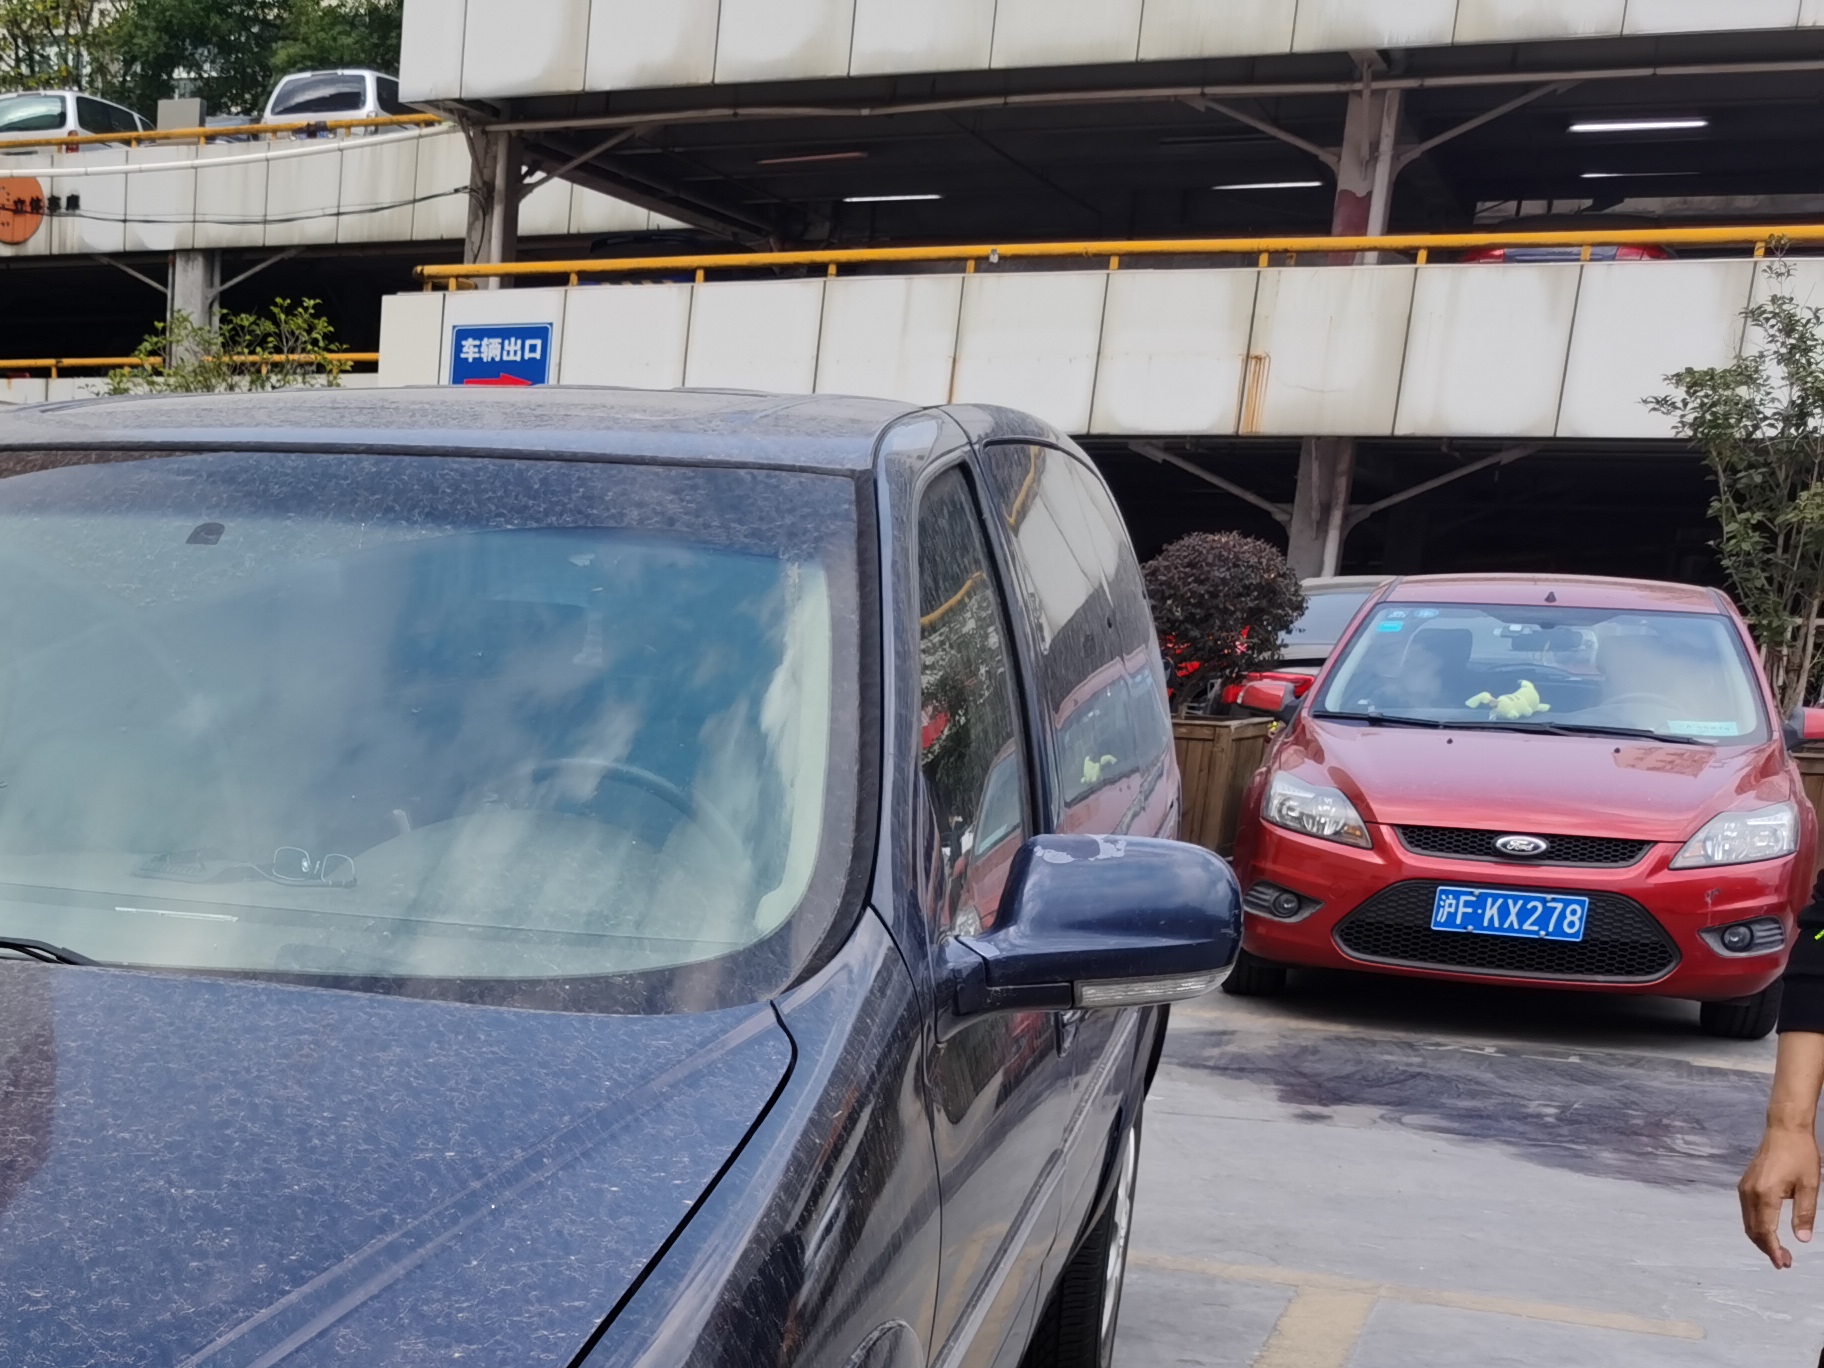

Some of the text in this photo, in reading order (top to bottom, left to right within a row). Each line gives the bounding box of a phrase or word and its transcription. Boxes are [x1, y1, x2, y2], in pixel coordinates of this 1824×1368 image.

[459, 336, 543, 363] 车辆出口
[1506, 839, 1535, 852] Ford
